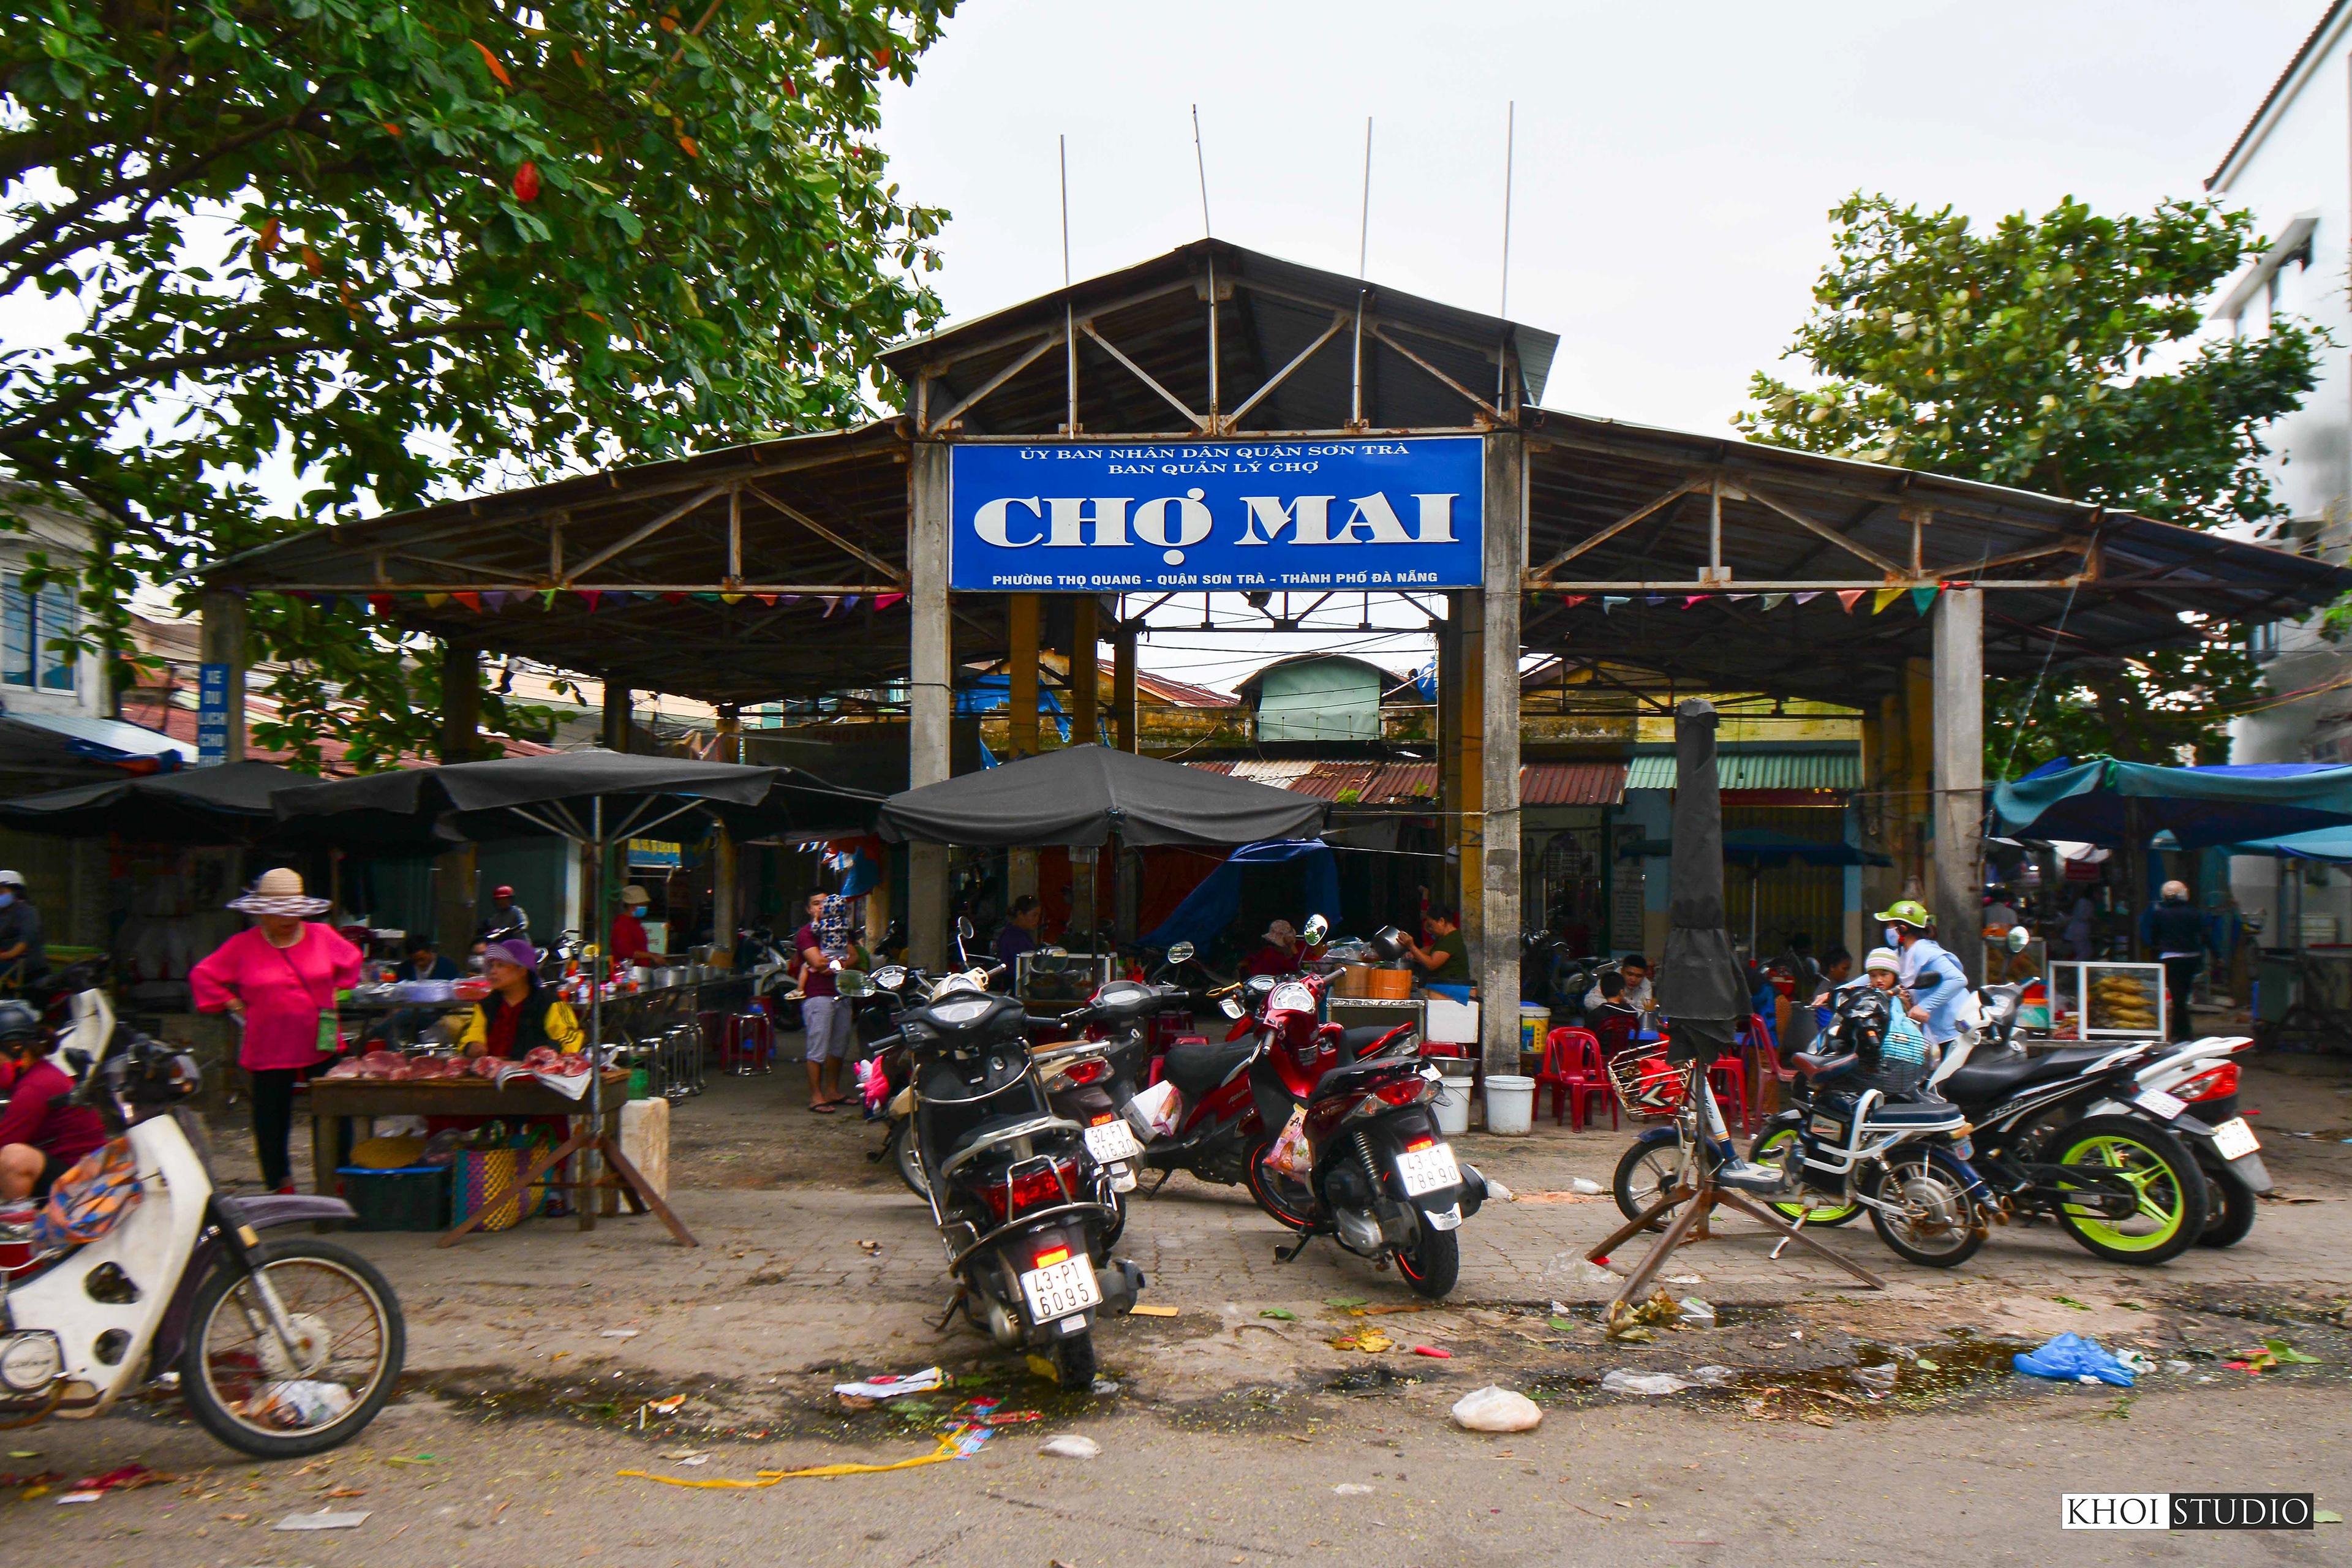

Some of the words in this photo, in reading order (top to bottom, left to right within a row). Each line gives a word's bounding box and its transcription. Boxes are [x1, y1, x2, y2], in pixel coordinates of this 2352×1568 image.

[1020, 447, 1050, 459] ỦY
[1057, 450, 1103, 459] BAN
[1109, 447, 1175, 459] NHÂN
[1182, 446, 1230, 458] DÂN
[1236, 445, 1302, 459] QUẬN
[1308, 445, 1356, 456] SƠN
[1362, 442, 1410, 454] TRÀ
[1108, 465, 1155, 474] BAN
[1161, 461, 1227, 475] QUẢN
[1233, 461, 1262, 473] LÝ
[1268, 461, 1319, 474] CHỢ
[974, 488, 1212, 566] CHỢ
[1233, 491, 1460, 545] MAI
[992, 573, 1053, 586] PHƯỜNG
[1057, 575, 1087, 588] THỌ
[1091, 575, 1141, 586] QUANG
[1157, 573, 1197, 587] QUẬN
[1202, 573, 1232, 584] SƠN
[1236, 572, 1265, 584] TRÀ
[1280, 571, 1331, 584] THÀNH
[1336, 570, 1368, 583] PHỐ
[1371, 571, 1392, 582] ĐÀ
[1397, 570, 1438, 582] NẴNG
[205, 670, 223, 684] XE
[204, 690, 222, 704] DU
[1039, 1283, 1089, 1316] 6095
